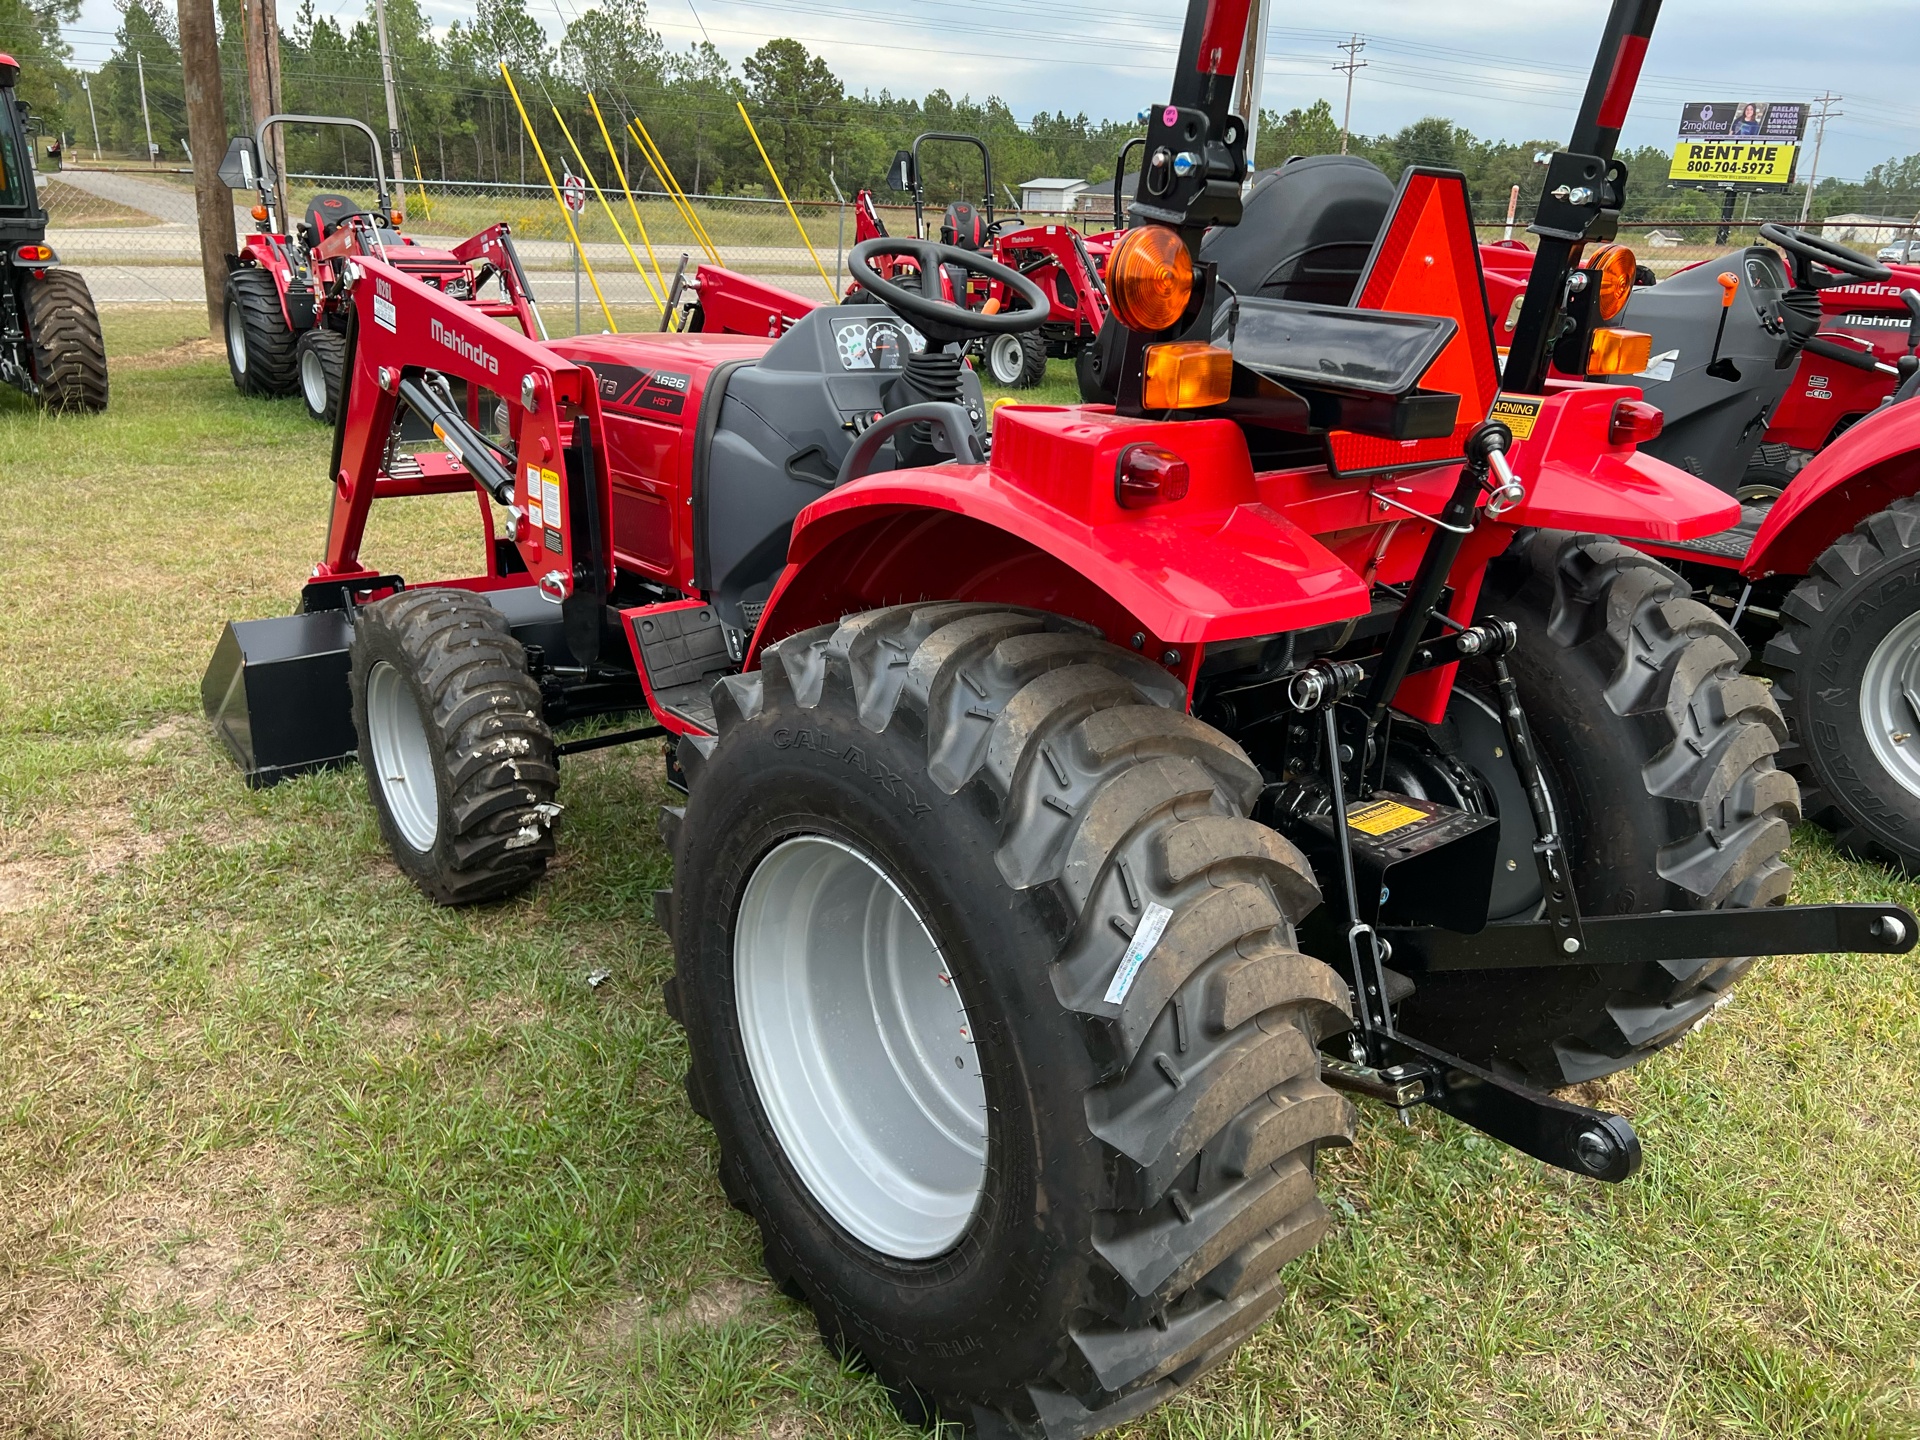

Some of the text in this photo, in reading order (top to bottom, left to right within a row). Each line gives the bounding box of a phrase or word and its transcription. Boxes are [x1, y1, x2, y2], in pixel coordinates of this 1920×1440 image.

[1682, 120, 1728, 132] 2mgkilled
[1689, 145, 1778, 161] RENT ME
[1687, 161, 1774, 174] 800-704-5973
[1844, 313, 1913, 328] Mahind
[431, 317, 499, 376] Mahindra
[655, 374, 686, 389] 1626
[652, 396, 673, 407] HST
[1494, 402, 1534, 415] ARNING
[772, 727, 933, 816] GALAXY
